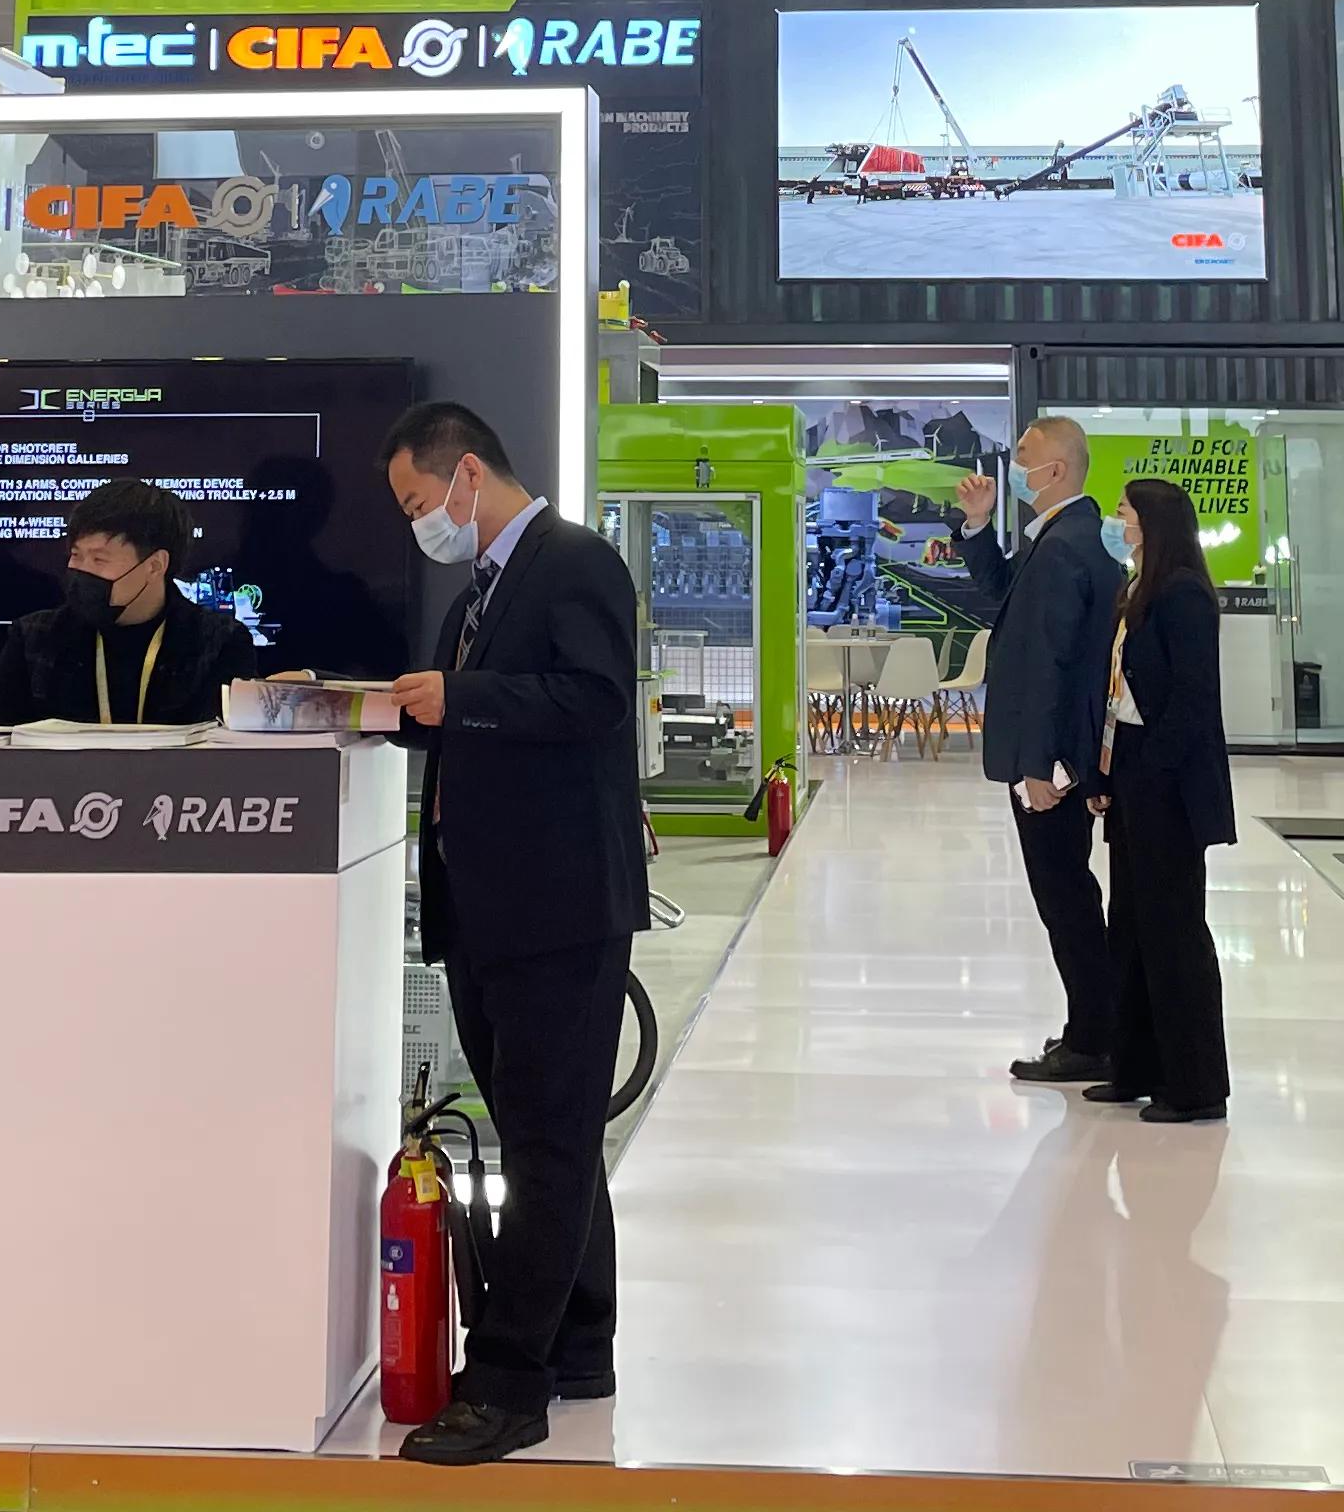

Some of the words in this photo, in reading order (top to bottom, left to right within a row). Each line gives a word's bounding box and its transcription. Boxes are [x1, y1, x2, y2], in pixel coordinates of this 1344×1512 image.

[22, 17, 196, 68] m-tec
[226, 26, 393, 69] CIFA
[539, 19, 702, 65] RABE
[623, 123, 689, 133] PRODUCTS
[24, 185, 199, 229] CIFA
[358, 176, 529, 224] RABE
[1171, 234, 1223, 248] CIFA
[66, 389, 162, 402] ENERGYA
[66, 401, 121, 410] SERIES
[11, 443, 77, 454] SHOTCRETE
[1210, 440, 1248, 456] FOR
[4, 454, 65, 465] DIMENSION
[67, 454, 129, 465] GALLERIES
[1123, 458, 1249, 475] SUSTAINABLE
[16, 479, 23, 489] 3
[25, 479, 59, 491] ARMS,
[155, 478, 201, 489] REMOTE
[203, 478, 244, 489] DEVICE
[1182, 478, 1249, 494] BETTER
[206, 489, 258, 500] TROLLEY
[268, 489, 284, 500] 2.5
[285, 489, 296, 500] M
[1199, 498, 1250, 513] LIVES
[14, 528, 61, 539] WHEELS
[177, 797, 299, 833] RABE
